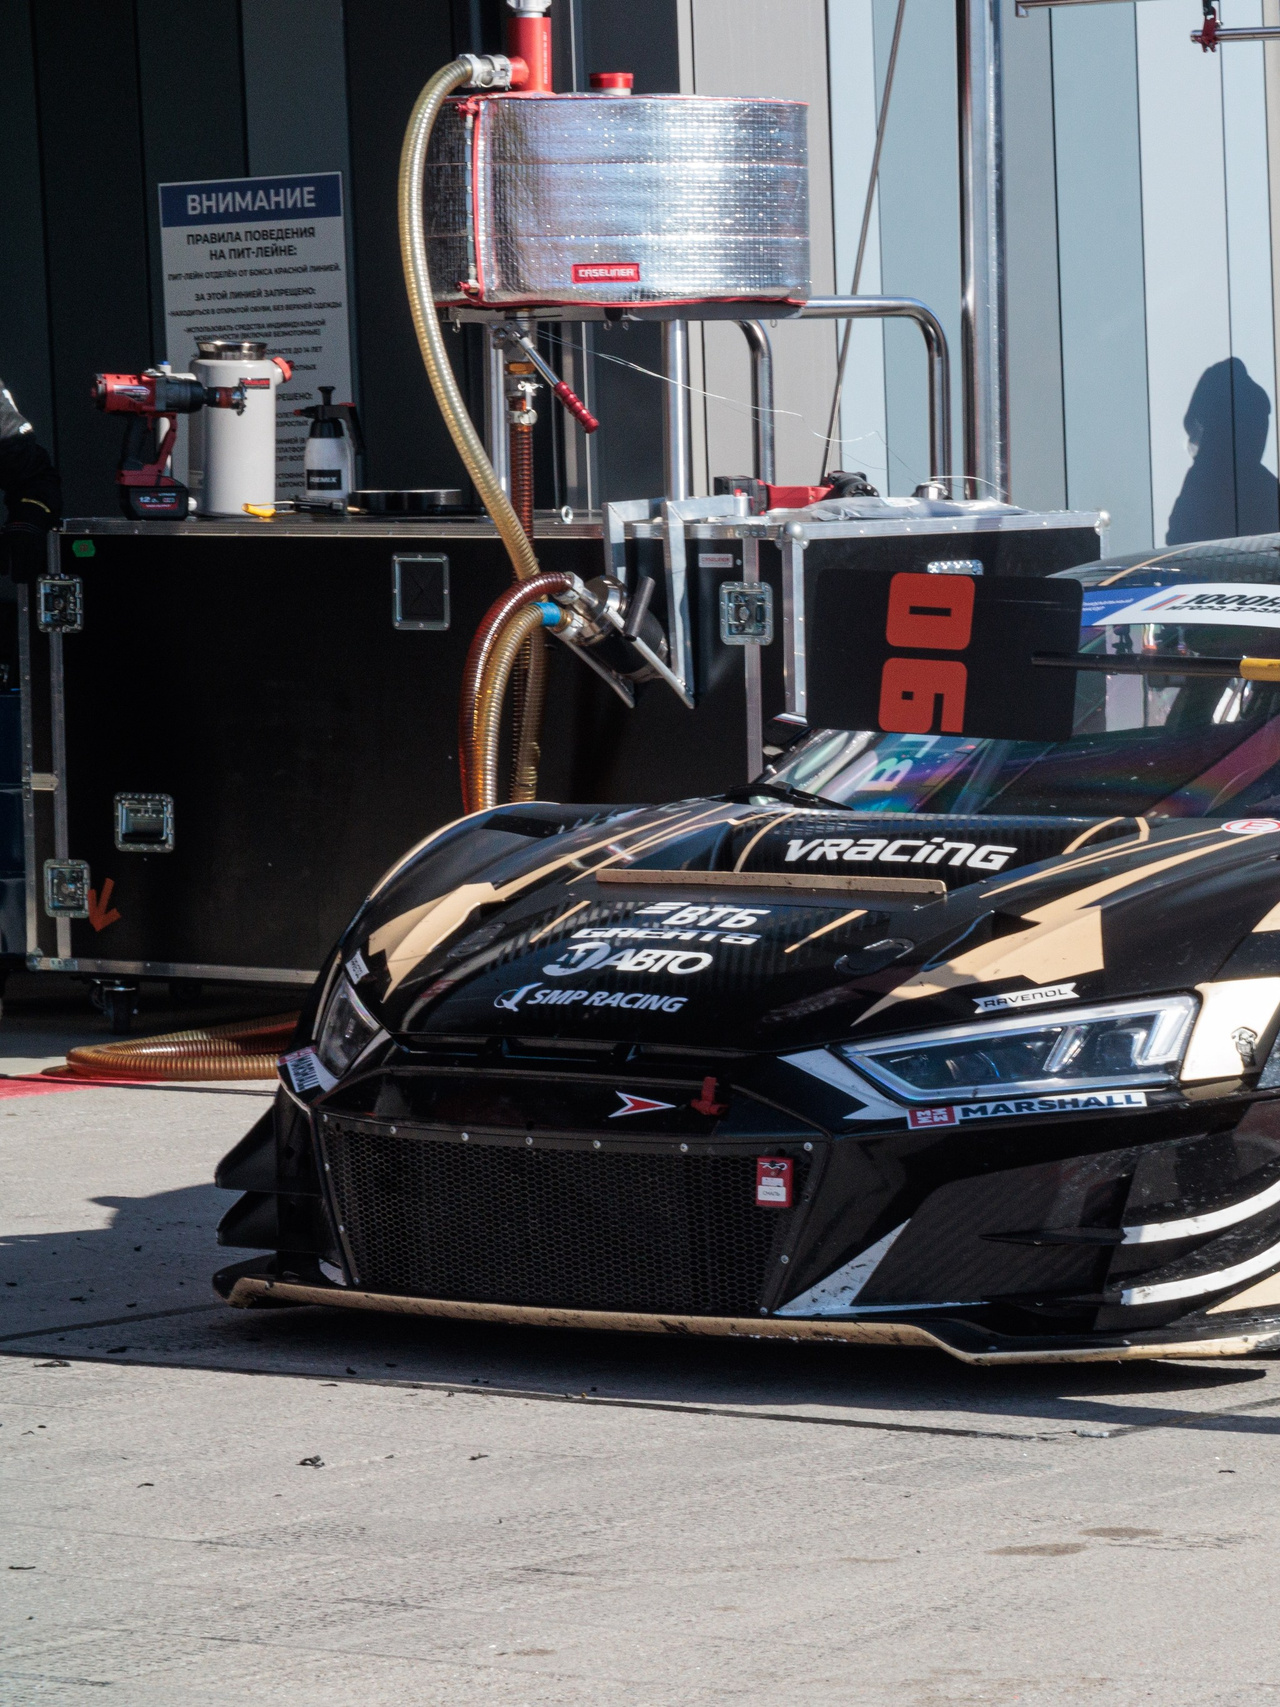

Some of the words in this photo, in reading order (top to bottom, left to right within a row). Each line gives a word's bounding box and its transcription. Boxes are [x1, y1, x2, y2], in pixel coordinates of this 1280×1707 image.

[187, 187, 317, 215] ВНИМАНИЕ
[186, 232, 241, 245] ПРАВИЛА
[245, 227, 315, 242] ПОВЕДЕНИЯ
[210, 250, 226, 261] НА
[229, 244, 297, 260] ПИТ-ЛЕЙНЕ:
[168, 272, 204, 281] ПИТ-ЛЕЙН
[239, 269, 248, 277] ОТ
[250, 267, 273, 276] БОКСА
[275, 265, 307, 275] КРАСНОЙ
[578, 267, 635, 278] CASELINER
[195, 293, 205, 301] ЗА
[207, 291, 228, 301] ЭТОЙ
[230, 289, 262, 299] ЛИНИЕЙ
[264, 287, 316, 298] ЗАПРЕЩЕНО:
[661, 905, 771, 928] ВТБ
[570, 927, 763, 945] GREATS
[526, 990, 584, 1005] SMP
[583, 991, 689, 1013] RACING
[983, 988, 1069, 1008] RAVENOL
[961, 1094, 1143, 1118] MARSHALL
